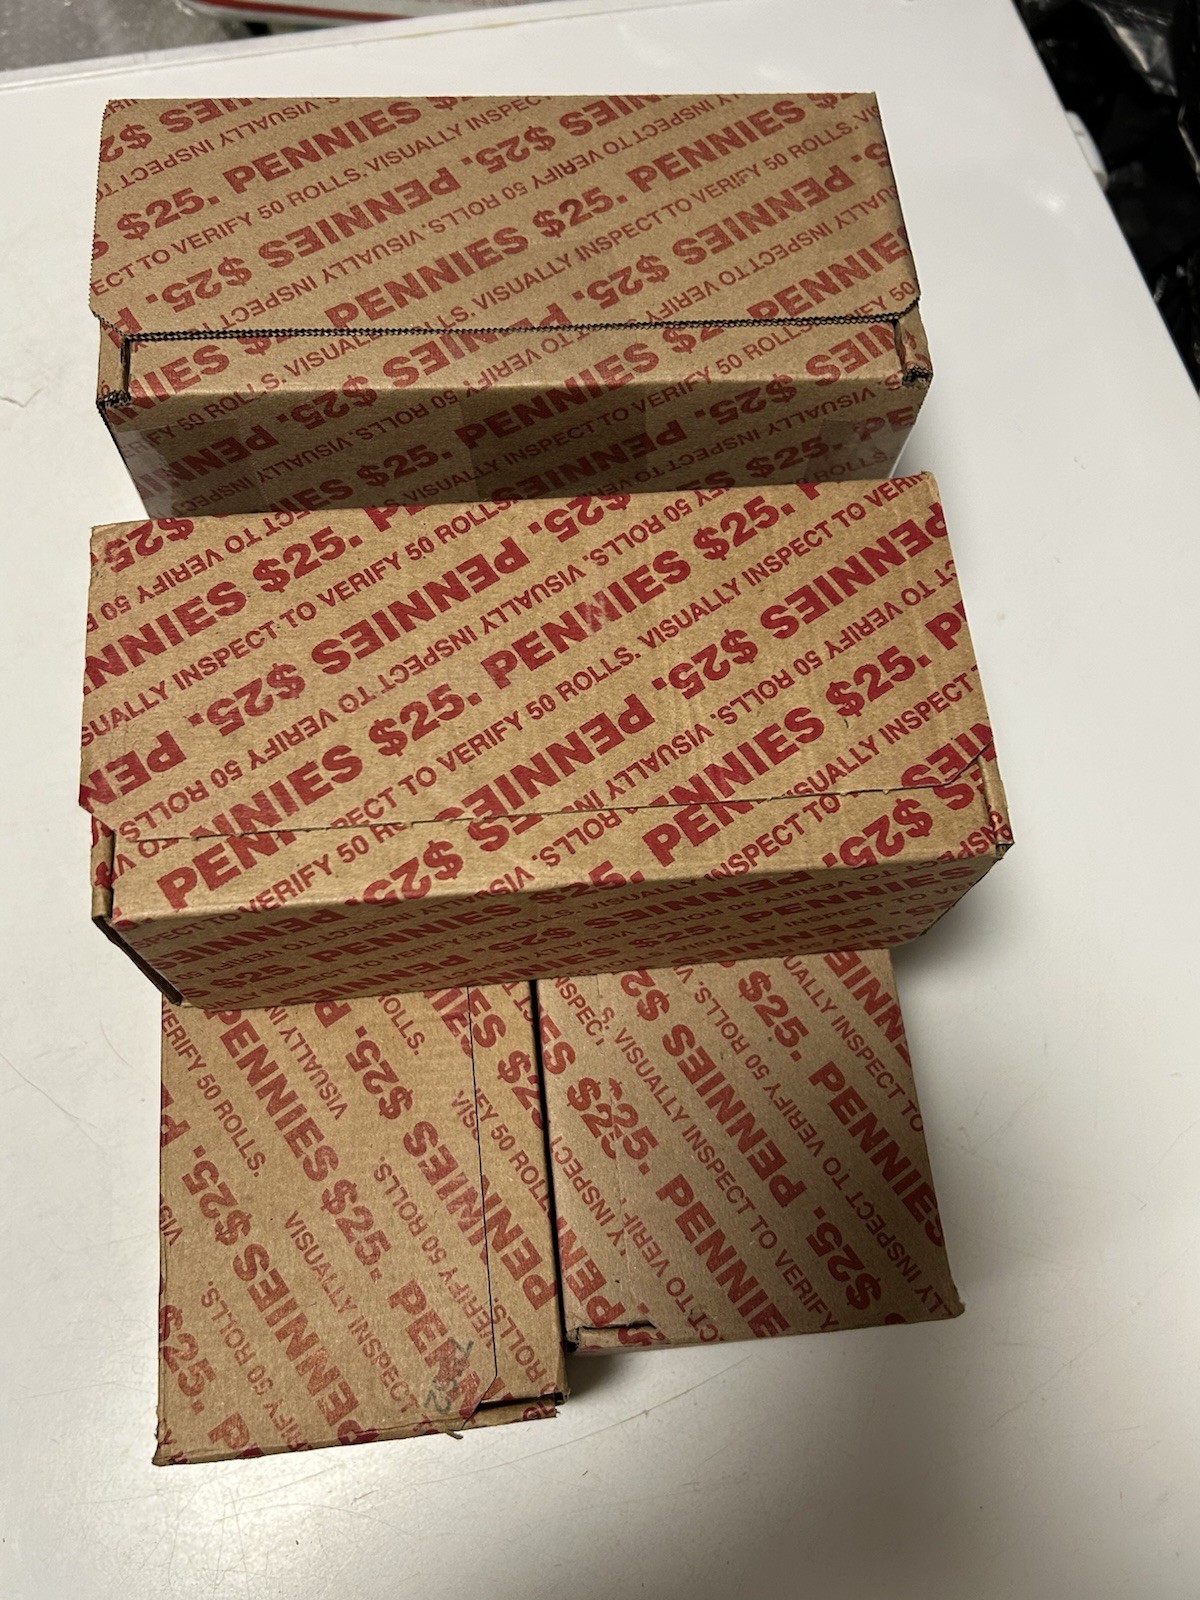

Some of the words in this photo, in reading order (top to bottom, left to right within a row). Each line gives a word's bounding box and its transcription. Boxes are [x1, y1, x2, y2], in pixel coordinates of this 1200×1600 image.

[603, 137, 633, 154] TO
[632, 100, 714, 143] INSPECT
[117, 188, 219, 240] $25.
[223, 101, 421, 193] PENNIES
[120, 139, 214, 188] INSPECT
[462, 126, 555, 173] $25.
[532, 150, 602, 188] VERIFY
[137, 249, 170, 269] TO
[171, 212, 251, 254] VERIFY
[257, 201, 285, 218] 50
[286, 168, 361, 206] ROLLS.
[364, 124, 461, 171] VISUALLY
[260, 167, 460, 268] PENNIES
[325, 227, 528, 336] PENNIES
[533, 187, 627, 237] $25.
[627, 100, 805, 192] PENNIES
[428, 194, 500, 233] ROLLS.
[472, 253, 571, 309] VISUALLY
[575, 210, 661, 261] INSPECT
[661, 198, 692, 216] TO
[691, 164, 760, 203] VERIFY
[764, 153, 788, 169] 50
[788, 122, 853, 158] ROLLS.
[502, 182, 527, 200] 50
[675, 165, 854, 264] PENNIES
[322, 229, 424, 283] VISUALLY
[749, 221, 832, 272] INSPECT
[146, 257, 251, 312] $25.
[220, 276, 317, 329] INSPECT
[572, 255, 669, 309] $25.
[718, 266, 749, 285] TO
[889, 281, 915, 300] 50
[431, 390, 458, 409] 50
[464, 348, 541, 398] VERIFY
[695, 375, 797, 424] $25.
[178, 413, 203, 431] 50
[276, 377, 377, 430] $25.
[355, 403, 429, 440] ROLLS.
[357, 444, 452, 486] $25.
[455, 344, 657, 449] PENNIES
[768, 387, 875, 435] VISUALLY
[258, 437, 352, 483] VISUALLY
[404, 459, 499, 512] VISUALLY
[504, 420, 594, 464] INSPECT
[598, 408, 629, 426] TO
[631, 367, 710, 413] VERIFY
[716, 354, 742, 374] 50
[679, 429, 760, 466] INSPECT
[635, 467, 664, 482] TO
[663, 499, 692, 521] 50
[225, 528, 262, 553] TO
[253, 526, 362, 592] $25.
[583, 515, 665, 566] ROLLS.
[137, 549, 223, 603] VERIFY
[480, 564, 584, 634] VISUALLY
[901, 580, 936, 605] TO
[100, 596, 131, 620] 50
[172, 621, 276, 690] INSPECT
[280, 602, 316, 627] TO
[317, 552, 401, 606] VERIFY
[404, 537, 434, 560] 50
[312, 537, 529, 674] PENNIES
[369, 684, 481, 756] $25.
[480, 550, 691, 689] PENNIES
[694, 496, 794, 560] $25.
[825, 602, 902, 659] VERIFY
[378, 625, 477, 693] INSPECT
[398, 766, 436, 795] TO
[437, 711, 523, 772] VERIFY
[526, 694, 555, 719] 50
[555, 647, 641, 701] ROLLS.
[637, 578, 741, 648] VISUALLY
[741, 521, 832, 586] INSPECT
[831, 503, 866, 527] TO
[651, 629, 757, 699] $25.
[793, 650, 822, 675] 50
[188, 663, 305, 736] $25.
[338, 686, 376, 713] TO
[711, 669, 795, 724] ROLLS.
[826, 646, 931, 716] $25.
[879, 673, 972, 744] INSPECT
[248, 709, 336, 770] VERIFY
[606, 723, 715, 800] VISUALLY
[211, 760, 243, 788] 50
[336, 835, 368, 863] 50
[532, 808, 622, 866] ROLLS.
[704, 813, 804, 888] INSPECT
[805, 793, 840, 822] TO
[823, 799, 933, 868] $25.
[204, 913, 240, 925] TO
[240, 854, 332, 919] VERIFY
[346, 840, 463, 931] $25.
[417, 866, 534, 915] VISUALLY
[584, 870, 812, 929] PENNIES
[628, 924, 730, 948] $25.
[739, 853, 974, 936] PENNIES
[764, 880, 852, 904] VERIFY
[859, 870, 891, 881] TO
[210, 964, 309, 988] $25.
[309, 904, 521, 963] PENNIES
[529, 861, 644, 904] $25.
[323, 912, 415, 942] INSPECT
[351, 960, 382, 969] TO
[391, 939, 460, 961] VERIFY
[469, 931, 492, 940] 50
[495, 910, 574, 932] ROLLS.
[589, 880, 697, 909] VISUALLY
[645, 909, 723, 929] ROLLS.
[728, 902, 750, 910] 50
[784, 902, 882, 928] INSPECT
[894, 893, 926, 903] TO
[207, 950, 280, 973] VERIFY
[282, 940, 317, 950] TO
[474, 928, 575, 953] $25.
[535, 930, 633, 958] VISUALLY
[694, 981, 750, 1054] ROLLS.
[739, 971, 809, 1061] $25.
[279, 1027, 348, 1120] VISUALLY
[346, 1026, 412, 1119] $25.
[745, 1054, 770, 1080] 50
[832, 1016, 905, 1098] INSPECT
[902, 1099, 923, 1132] TO
[197, 1074, 221, 1100] 50
[213, 1100, 266, 1176] ROLLS.
[491, 1124, 515, 1151] 50
[663, 1024, 807, 1207] PENNIES
[763, 1084, 825, 1156] VERIFY
[181, 1146, 251, 1245] $25.
[373, 1156, 427, 1236] ROLLS.
[615, 1027, 689, 1122] VISUALLY
[683, 1125, 755, 1214] INSPECT
[751, 1215, 777, 1249] TO
[775, 1249, 839, 1329] VERIFY
[823, 1158, 850, 1189] TO
[321, 1179, 391, 1281] $25.
[421, 1236, 447, 1264] 50
[846, 1192, 921, 1283] INSPECT
[806, 1207, 881, 1310] $25.
[284, 1211, 357, 1313] VISUALLY
[348, 1316, 416, 1401] INSPECT
[666, 1278, 693, 1313] TO
[200, 1281, 256, 1366] ROLLS.
[233, 1244, 380, 1446] PENNIES
[247, 1366, 273, 1395] 50
